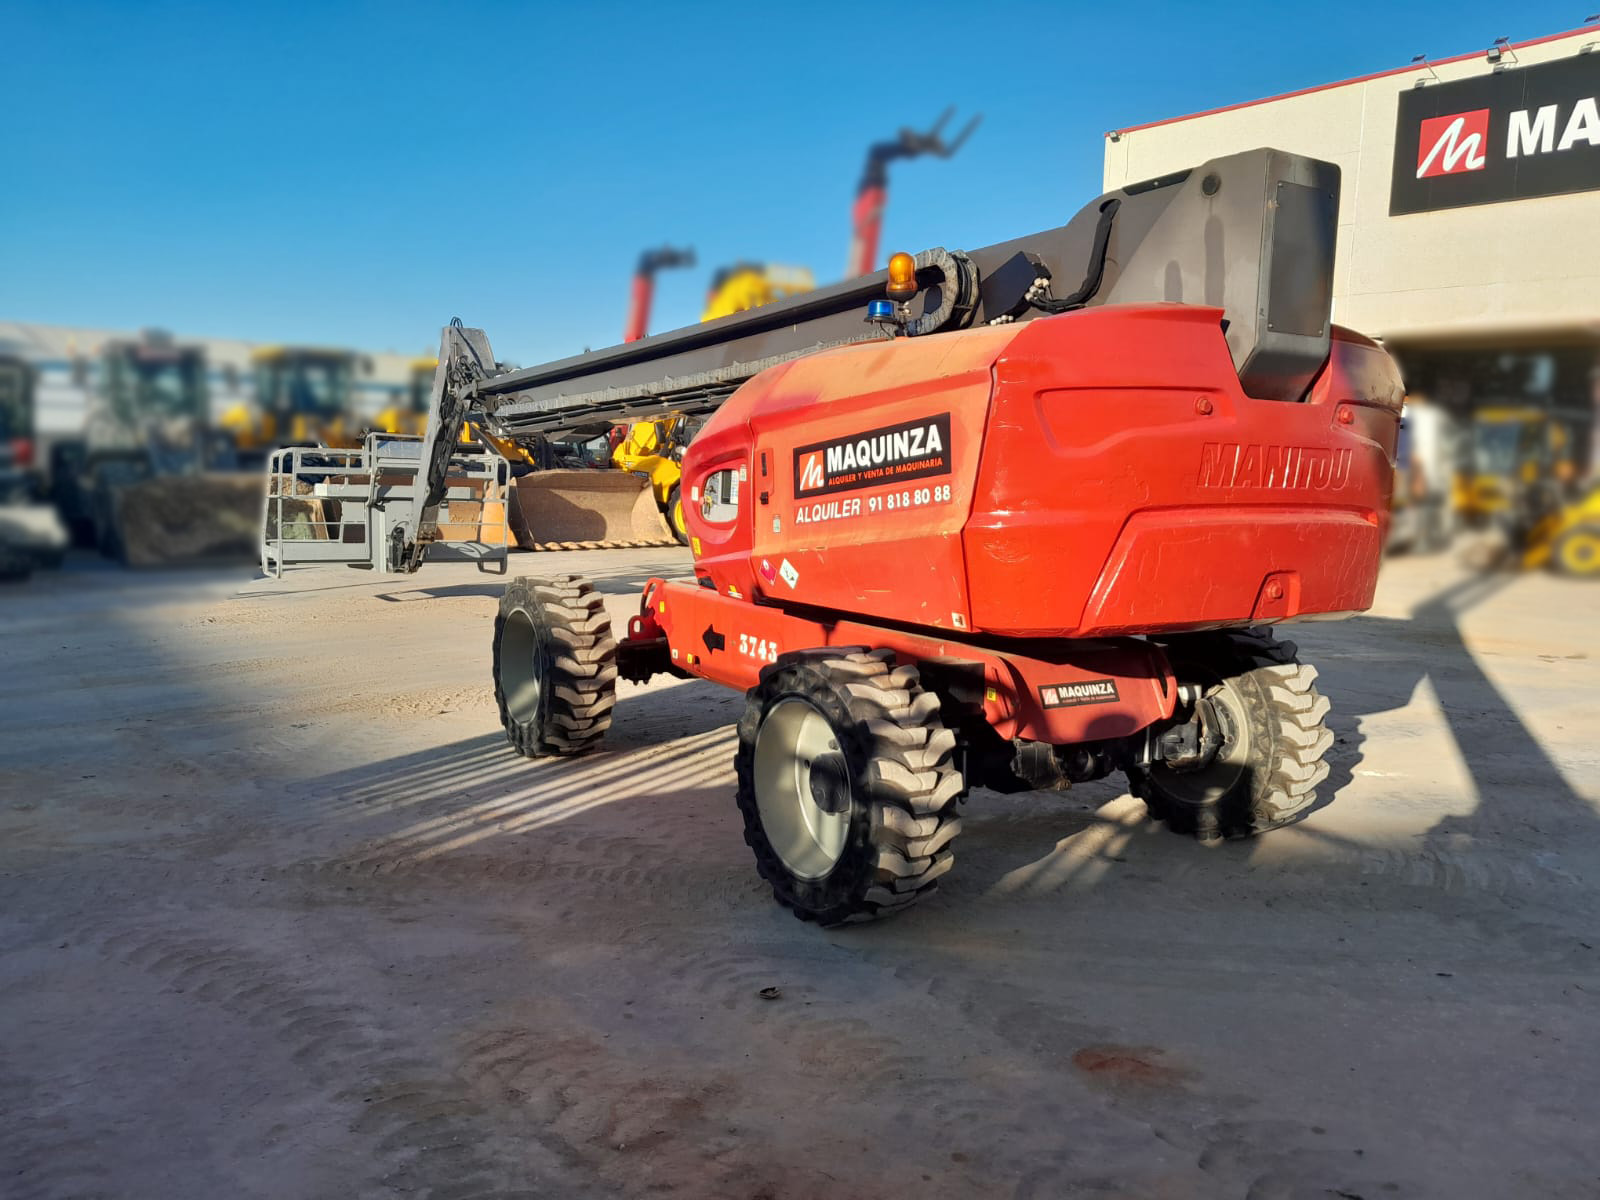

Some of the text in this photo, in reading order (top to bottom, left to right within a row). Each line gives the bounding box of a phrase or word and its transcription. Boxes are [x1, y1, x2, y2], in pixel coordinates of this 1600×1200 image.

[1506, 97, 1600, 159] MA
[827, 424, 942, 473] MAQUINZA
[1197, 442, 1353, 491] MANITOU
[828, 457, 943, 486] ALQUILER Y VENTA DE MAQUINARIA
[795, 484, 951, 524] ALQUILER 91 818 80 88
[739, 633, 778, 663] 3743
[1058, 682, 1115, 698] MAQUINZA
